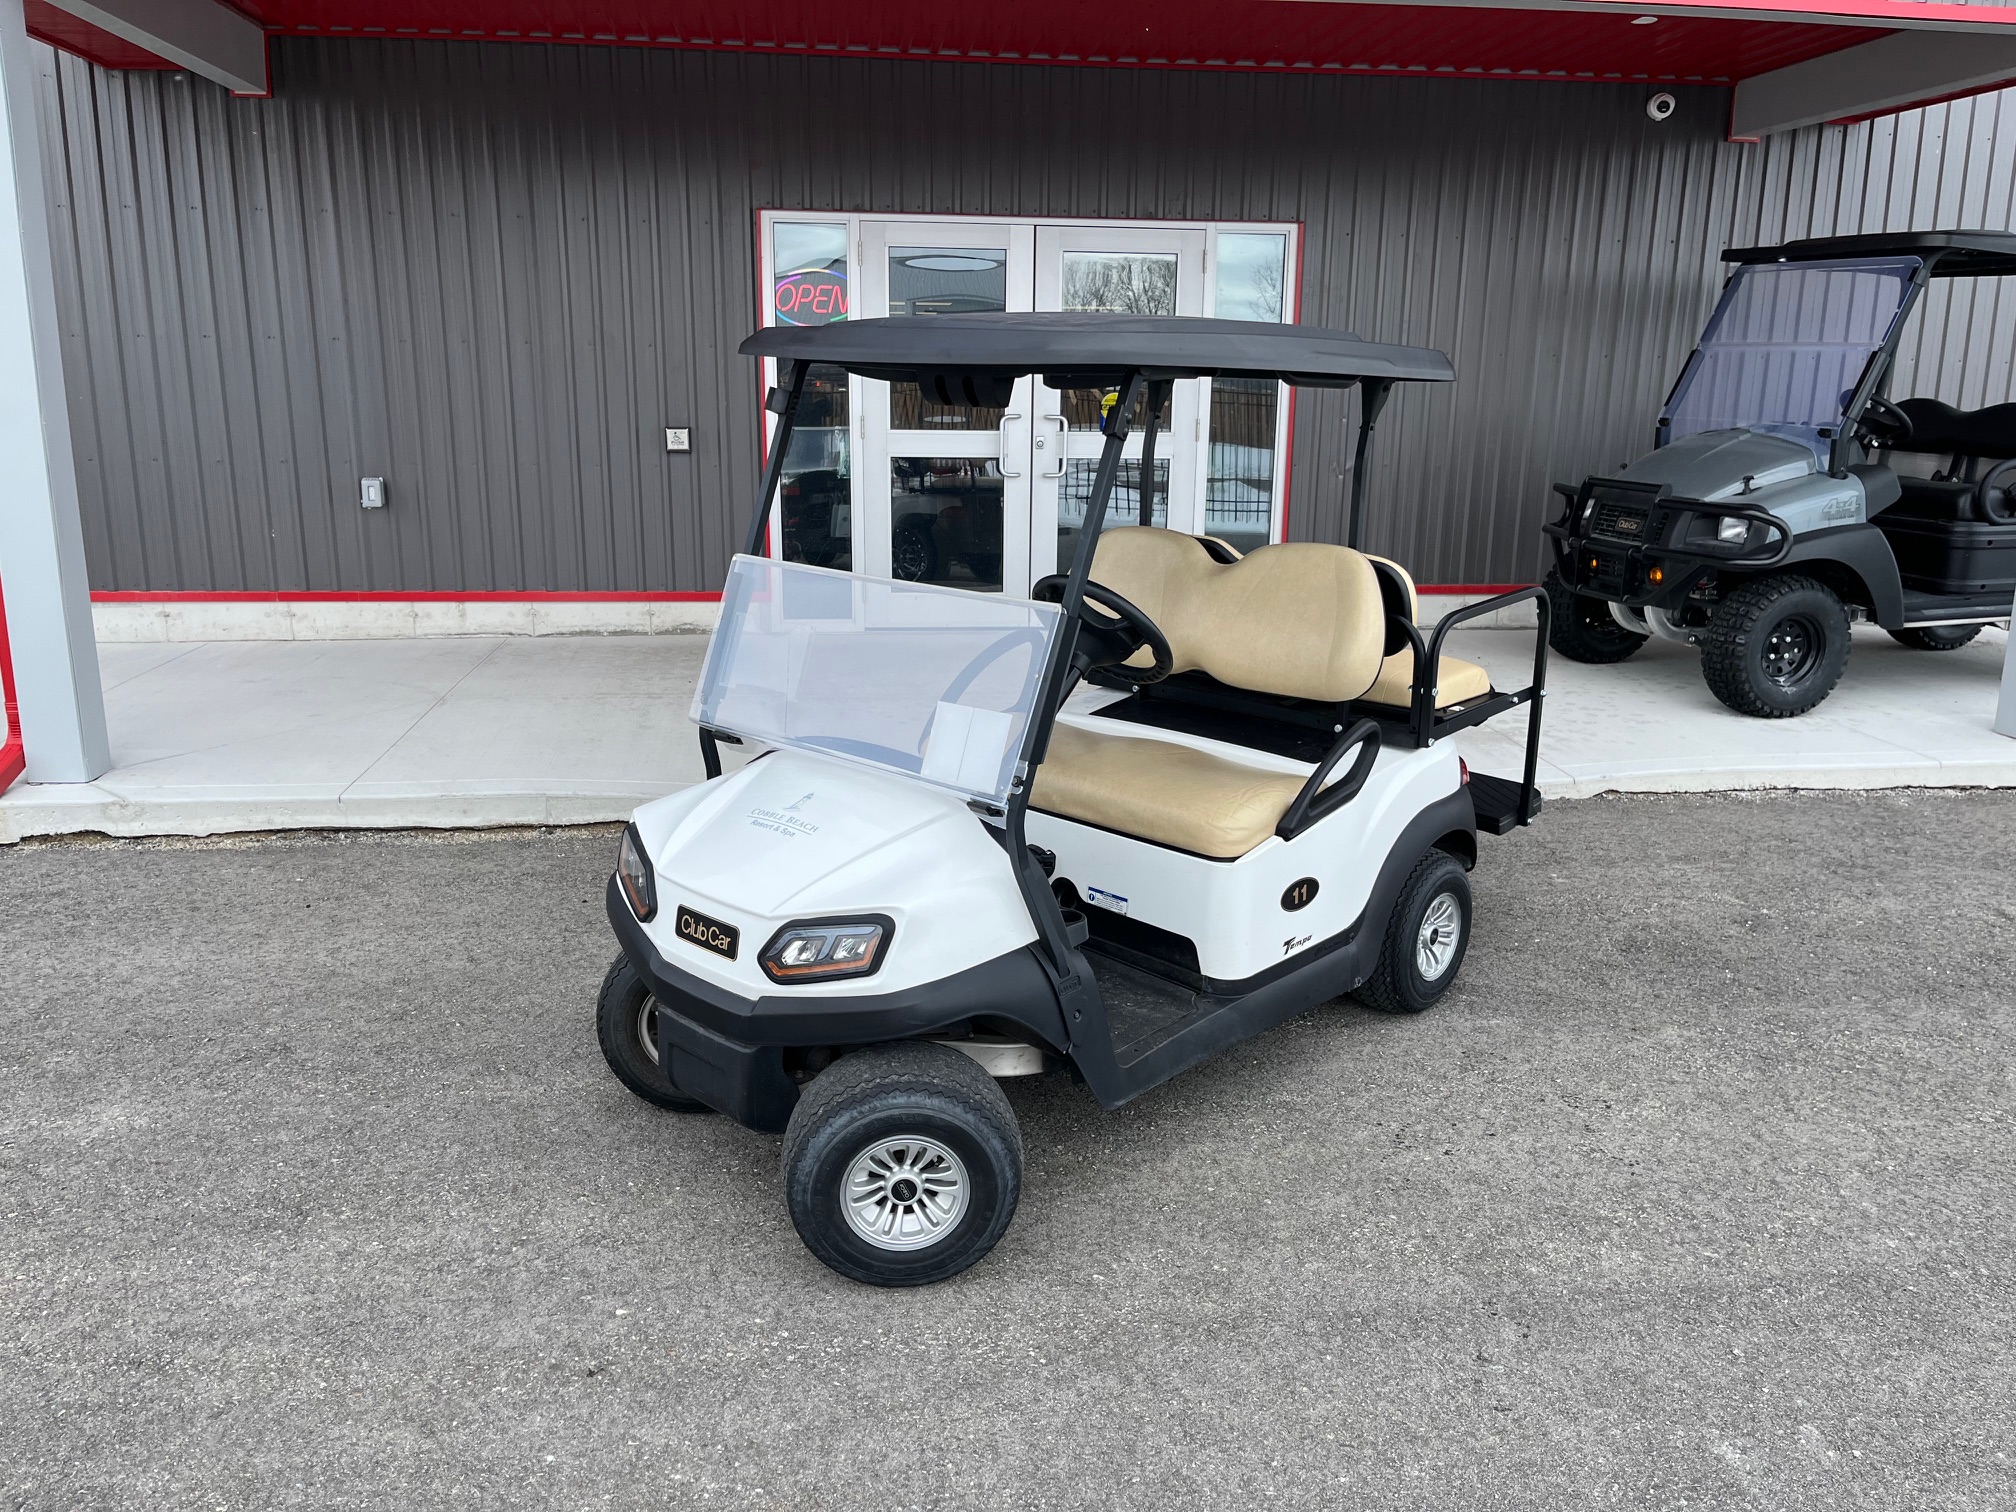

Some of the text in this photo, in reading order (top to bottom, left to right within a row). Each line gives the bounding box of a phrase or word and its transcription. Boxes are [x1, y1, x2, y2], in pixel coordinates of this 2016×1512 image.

[776, 284, 849, 314] OPEN
[750, 808, 819, 833] COBBLE BEACH
[750, 819, 774, 830] Resort
[780, 827, 796, 838] Spa
[1292, 884, 1308, 905] 11
[681, 914, 731, 951] Club Car
[1282, 934, 1313, 956] Tempo
